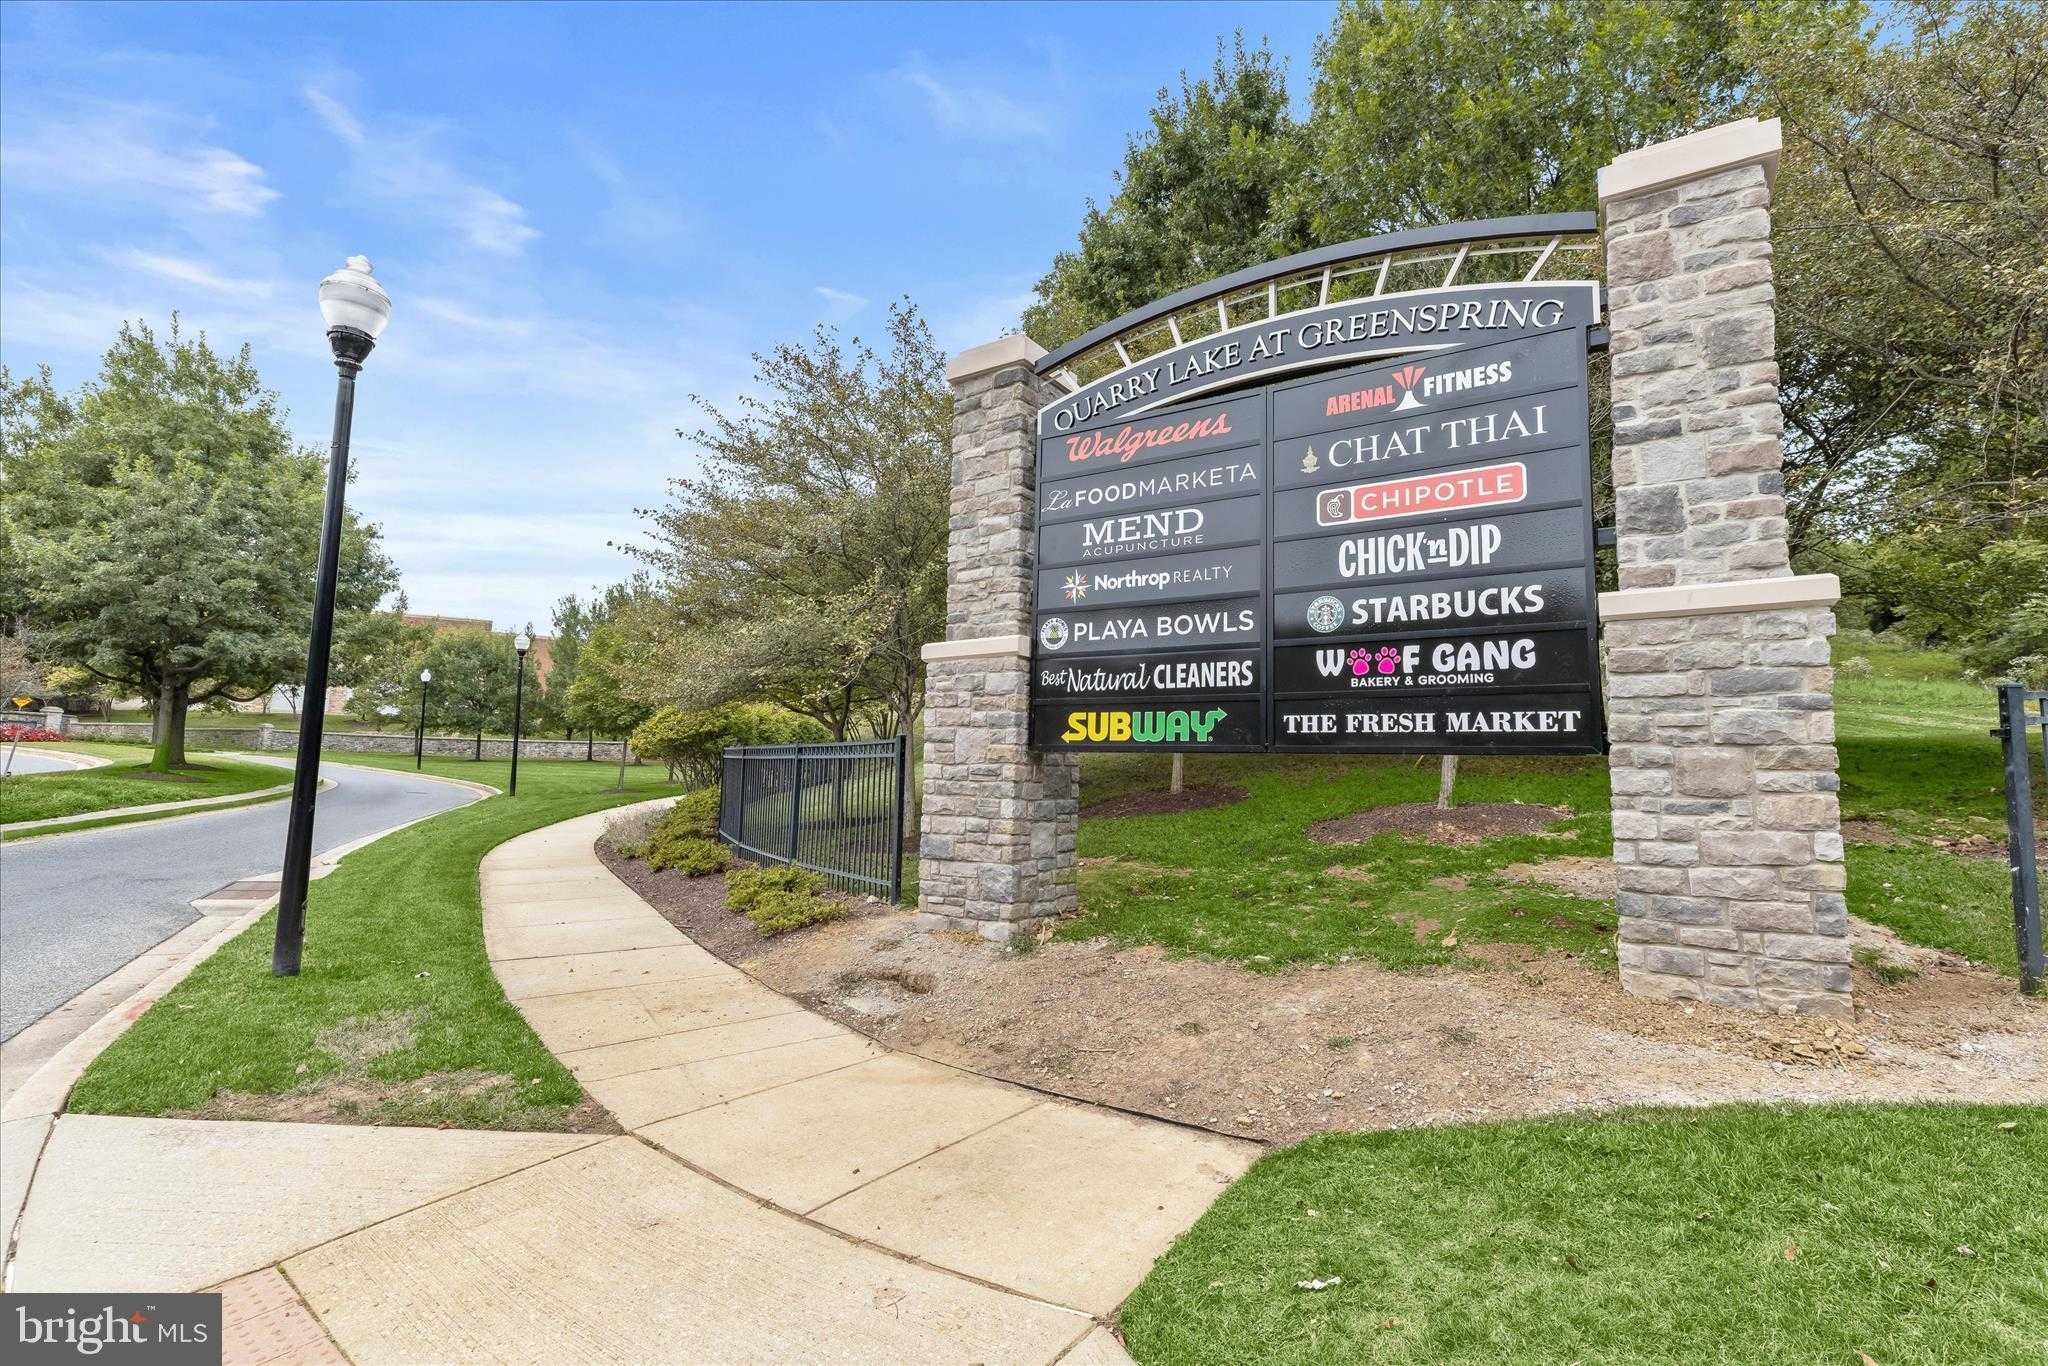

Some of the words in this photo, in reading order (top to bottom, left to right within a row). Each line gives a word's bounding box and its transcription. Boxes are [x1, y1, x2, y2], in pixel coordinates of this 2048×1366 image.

[1054, 366, 1163, 431] QUARRY
[1168, 340, 1243, 388] LAKE
[1247, 328, 1292, 372] AT
[1297, 299, 1566, 350] GREENSPRING
[1325, 385, 1396, 417] ARENAL
[1423, 360, 1513, 397] FITNESS
[1066, 412, 1233, 463] Walgreens
[1328, 425, 1431, 468] CHAT
[1440, 404, 1549, 449] THAI
[1041, 489, 1073, 513] La
[1360, 473, 1515, 511] CHIPOTLE
[1082, 508, 1205, 547] MEND
[1082, 534, 1205, 560] ACUPUNCTURE
[1094, 570, 1171, 591] Northrop
[1173, 565, 1233, 584] REALTY
[1351, 584, 1545, 626] STARBUCKS
[1074, 618, 1149, 642] PLAYA
[1157, 610, 1255, 636] BOWLS
[1431, 638, 1537, 672] GANG
[1041, 669, 1067, 687] Best
[1066, 663, 1151, 693] Natural
[1153, 660, 1254, 690] CLEANERS
[1350, 676, 1401, 688] BAKERY
[1404, 676, 1414, 686] &
[1418, 672, 1495, 685] GROOMING
[1061, 706, 1229, 744] SUBWAY
[1283, 713, 1337, 734] THE
[1345, 712, 1436, 733] FRESH
[1445, 710, 1581, 732] MARKET
